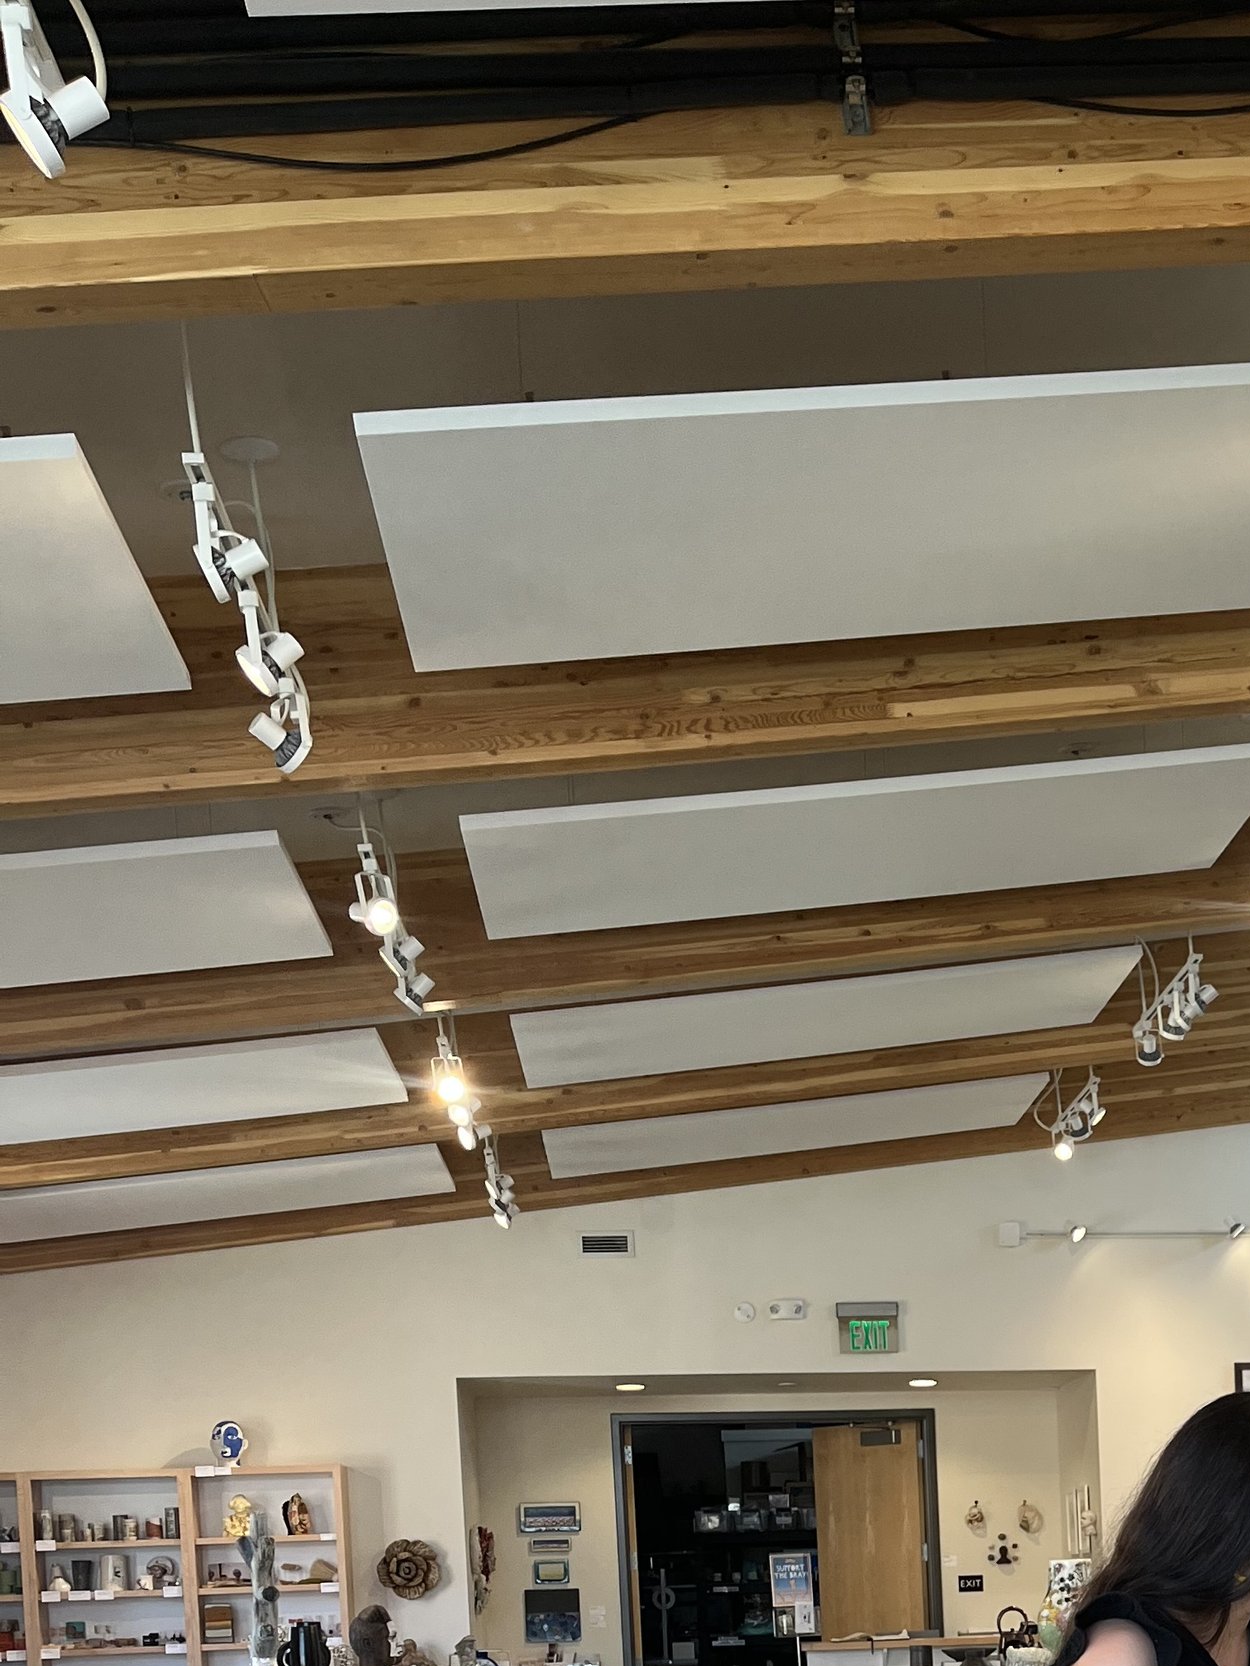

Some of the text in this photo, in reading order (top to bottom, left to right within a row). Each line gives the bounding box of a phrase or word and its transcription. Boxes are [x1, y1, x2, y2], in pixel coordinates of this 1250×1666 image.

[849, 1320, 889, 1351] EXIT
[776, 1564, 805, 1572] SUPPORT
[774, 1572, 788, 1580] THE
[960, 1579, 981, 1588] EXIT
